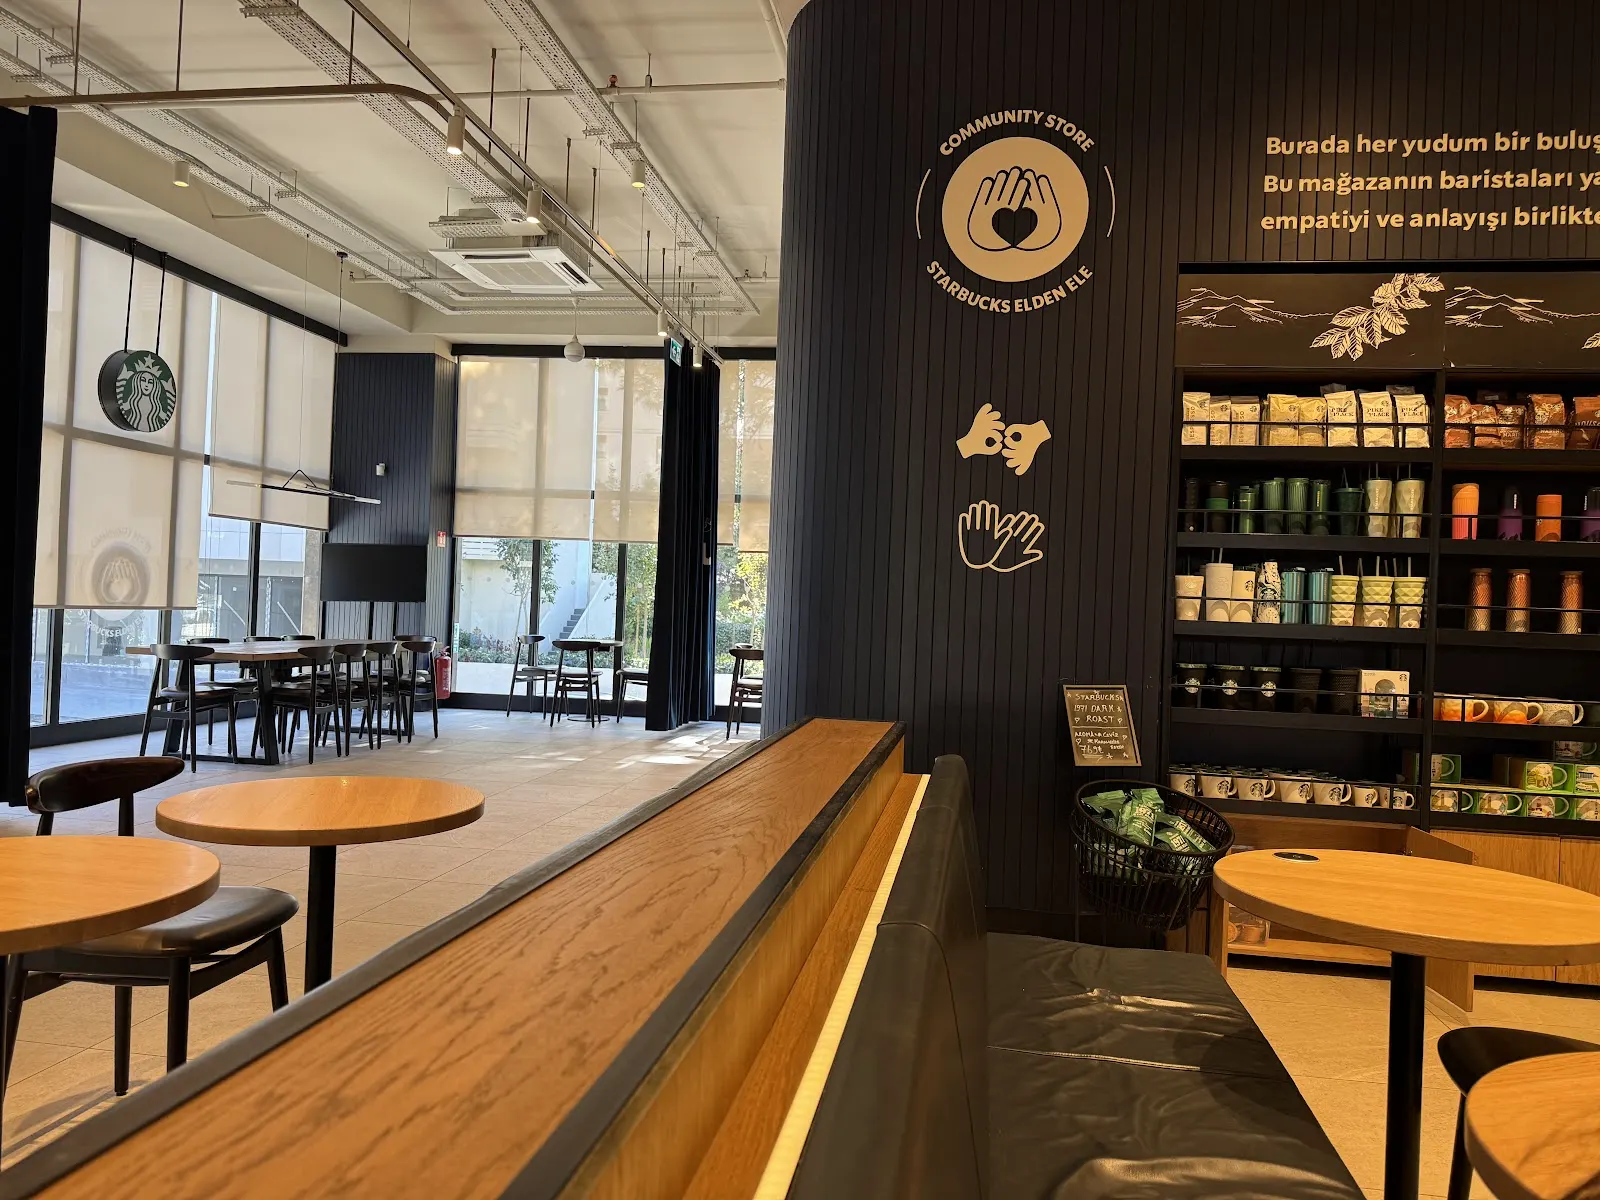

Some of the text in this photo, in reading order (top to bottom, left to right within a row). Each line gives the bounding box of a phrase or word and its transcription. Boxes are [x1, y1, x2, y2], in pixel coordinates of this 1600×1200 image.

[939, 109, 1095, 156] COMMUNITY STORE
[1265, 134, 1350, 155] Burada
[1356, 134, 1397, 154] her
[1402, 133, 1488, 157] yudum
[1495, 130, 1530, 152] bir
[1263, 175, 1293, 193] Bu
[1298, 172, 1433, 195] mağazanın
[1440, 168, 1573, 190] baristaları
[1260, 209, 1370, 234] empatiyi
[1376, 213, 1404, 228] ve
[1409, 207, 1507, 232] anlayışı
[926, 260, 1093, 314] STARBUCKS ELDEN ELE
[1074, 704, 1115, 713] 1971 DARK
[1086, 715, 1114, 723] ROAST
